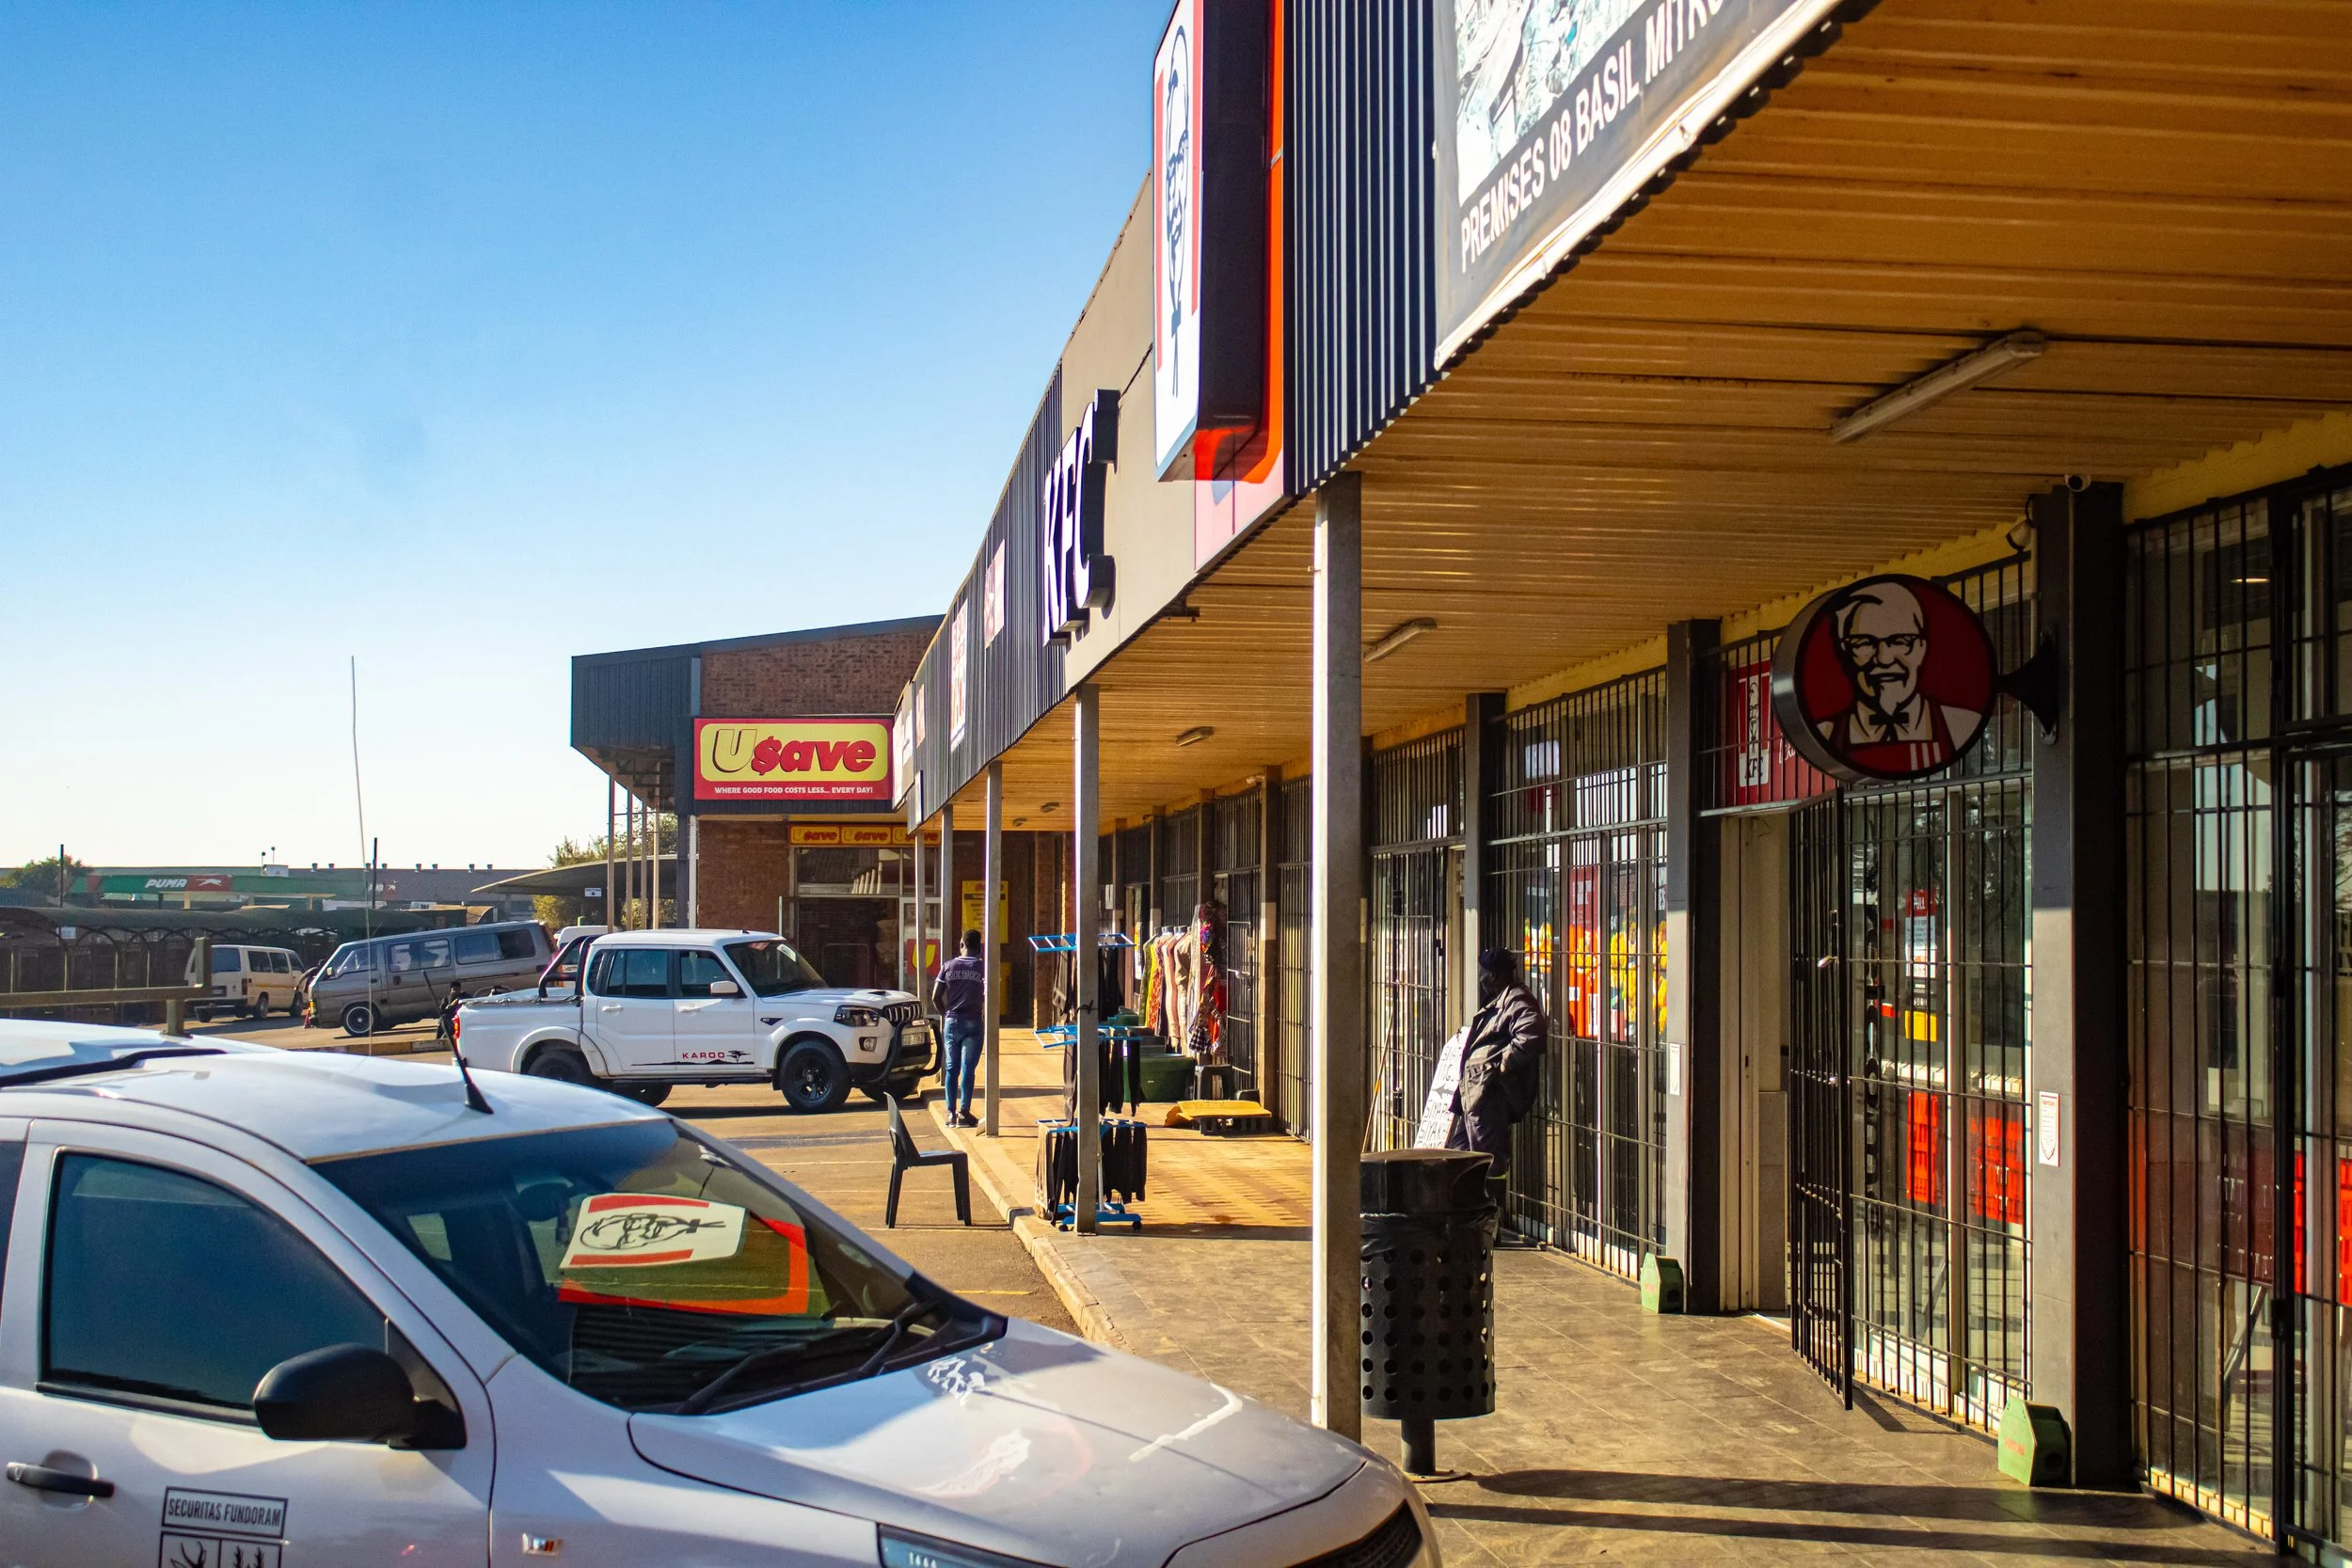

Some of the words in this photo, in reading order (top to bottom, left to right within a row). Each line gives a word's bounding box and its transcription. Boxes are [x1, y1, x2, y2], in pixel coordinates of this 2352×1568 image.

[1460, 136, 1545, 274] PREMISES
[1549, 108, 1571, 182] 08
[1576, 39, 1640, 156] BASIL
[1043, 388, 1116, 647] KFC
[145, 879, 188, 889] PUMA
[167, 1497, 222, 1521] SECURITAS
[223, 1503, 282, 1527] FUNDORAM
